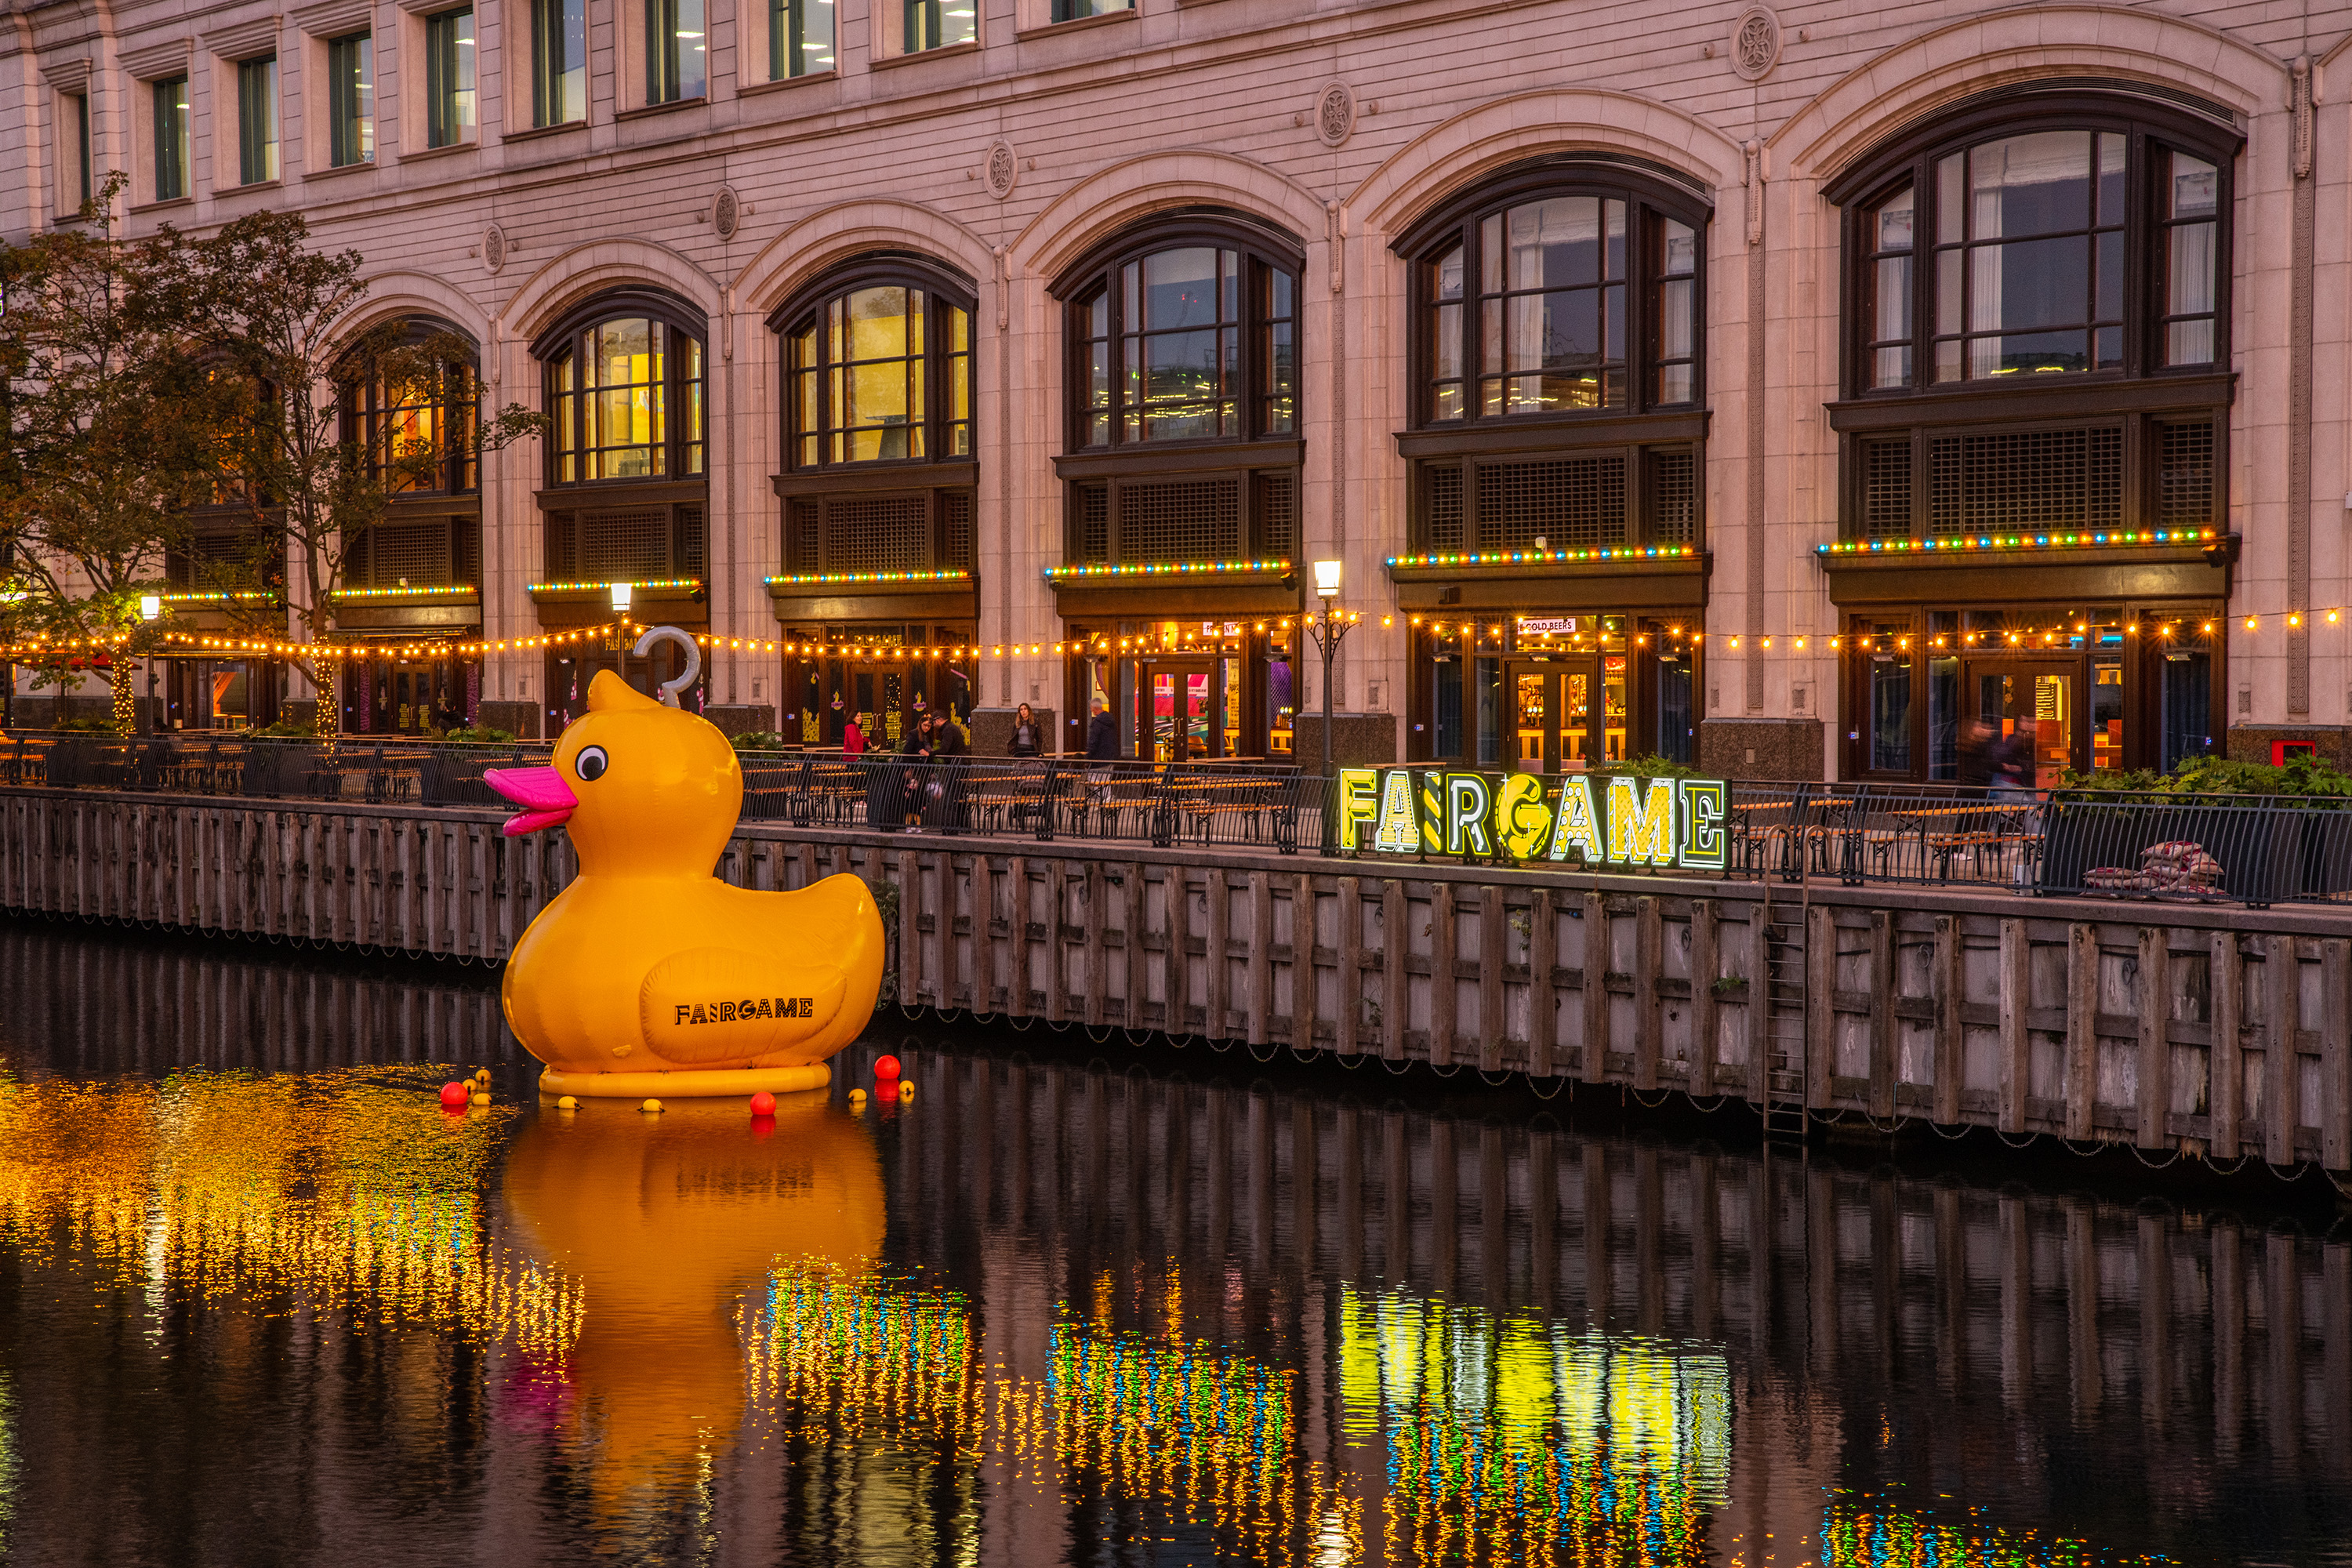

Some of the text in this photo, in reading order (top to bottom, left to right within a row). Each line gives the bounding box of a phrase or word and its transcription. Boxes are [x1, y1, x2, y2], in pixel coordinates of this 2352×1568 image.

[1526, 622, 1547, 631] COLD
[1549, 621, 1572, 630] BEERS
[854, 634, 902, 648] FAIRGAME
[1340, 768, 1725, 869] FAIRGAME
[674, 997, 813, 1025] FAIRGAME
